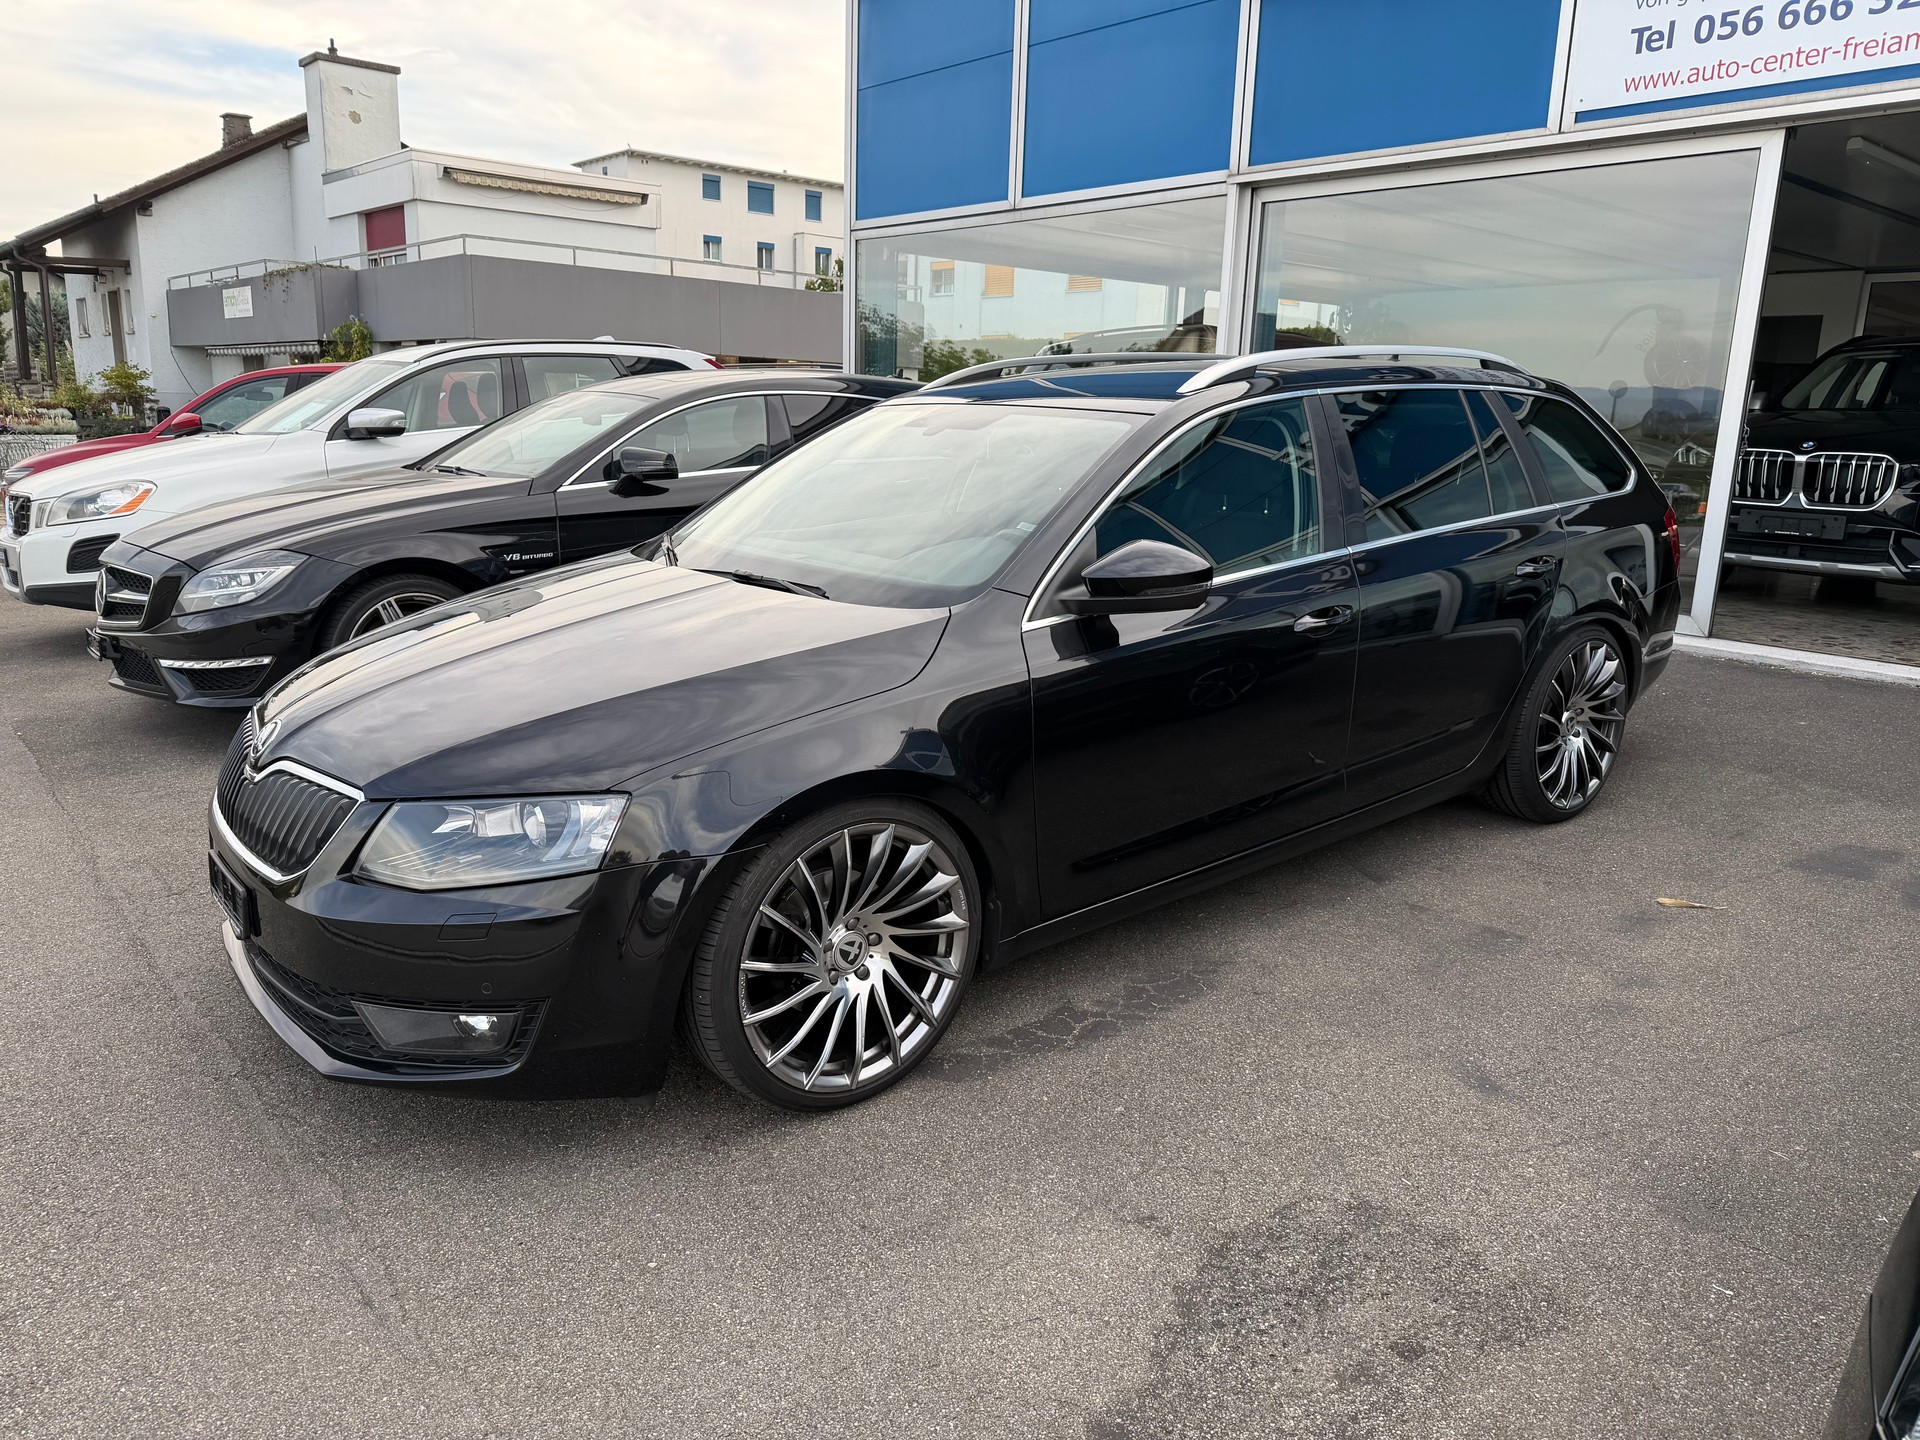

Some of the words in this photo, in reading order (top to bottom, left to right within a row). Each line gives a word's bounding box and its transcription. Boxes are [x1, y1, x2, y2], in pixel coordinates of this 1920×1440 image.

[1630, 20, 1676, 55] Tel
[1693, 5, 1763, 44] 056
[1777, 0, 1853, 30] 666
[503, 553, 521, 561] V8
[522, 552, 554, 560] BITURBO
